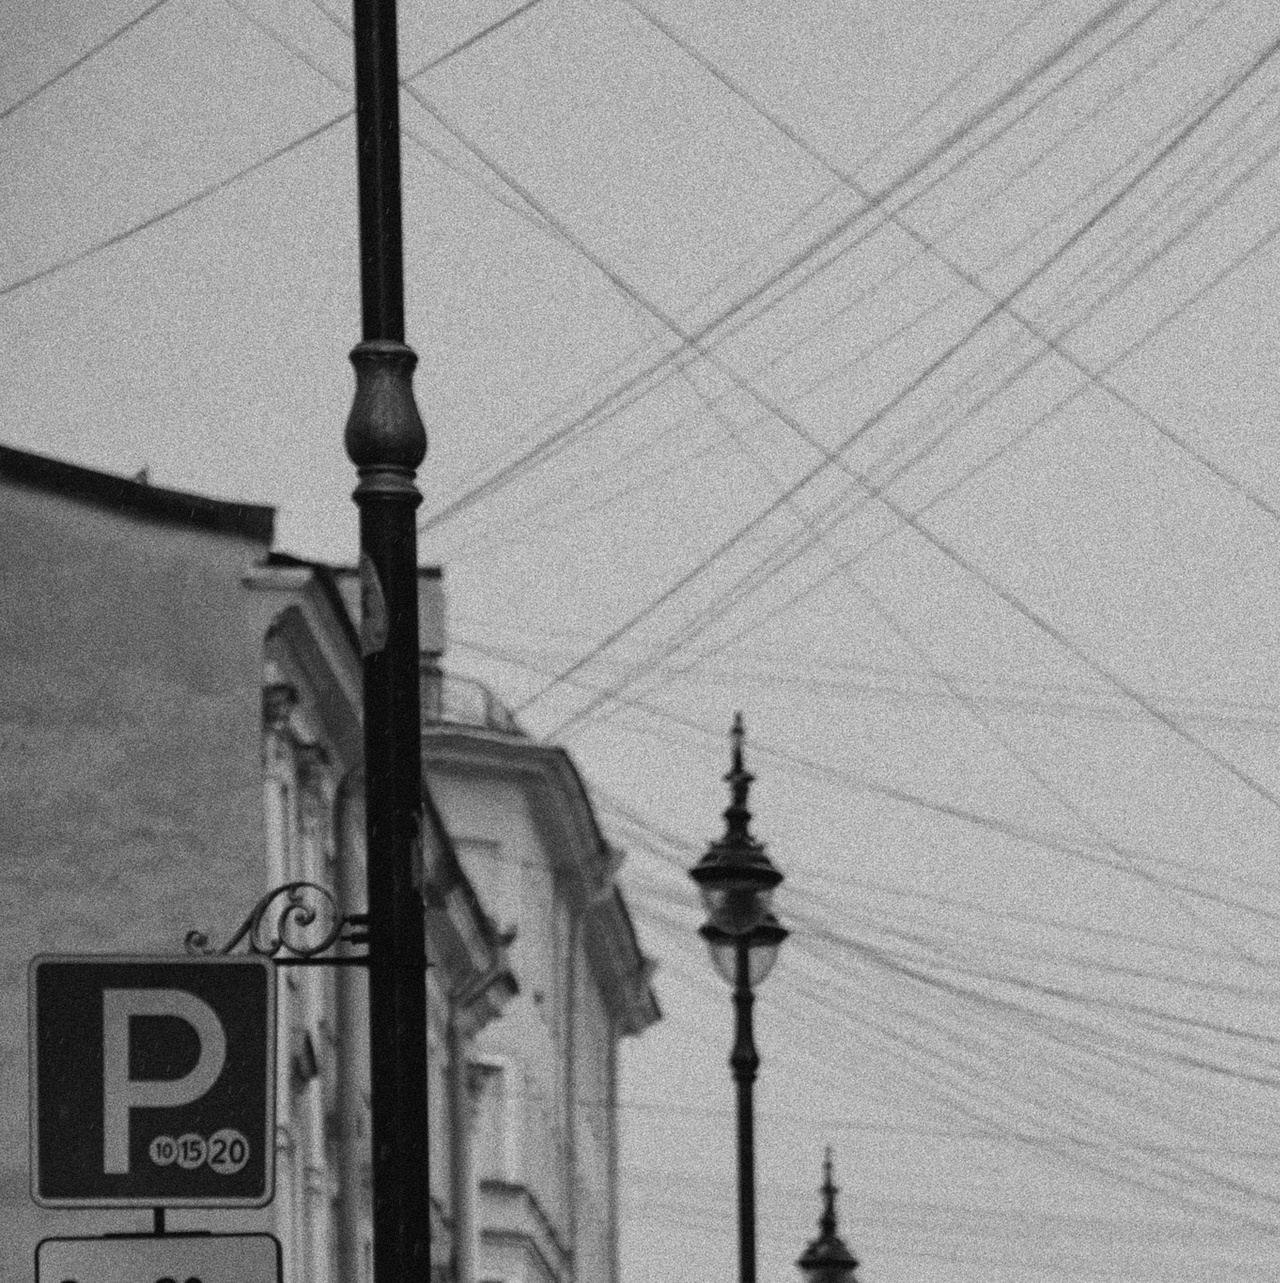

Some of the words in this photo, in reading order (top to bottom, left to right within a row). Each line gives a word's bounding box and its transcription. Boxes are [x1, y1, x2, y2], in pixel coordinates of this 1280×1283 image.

[103, 988, 226, 1174] P
[155, 1142, 172, 1161] 10
[180, 1140, 202, 1163] 15
[210, 1136, 246, 1166] 20
